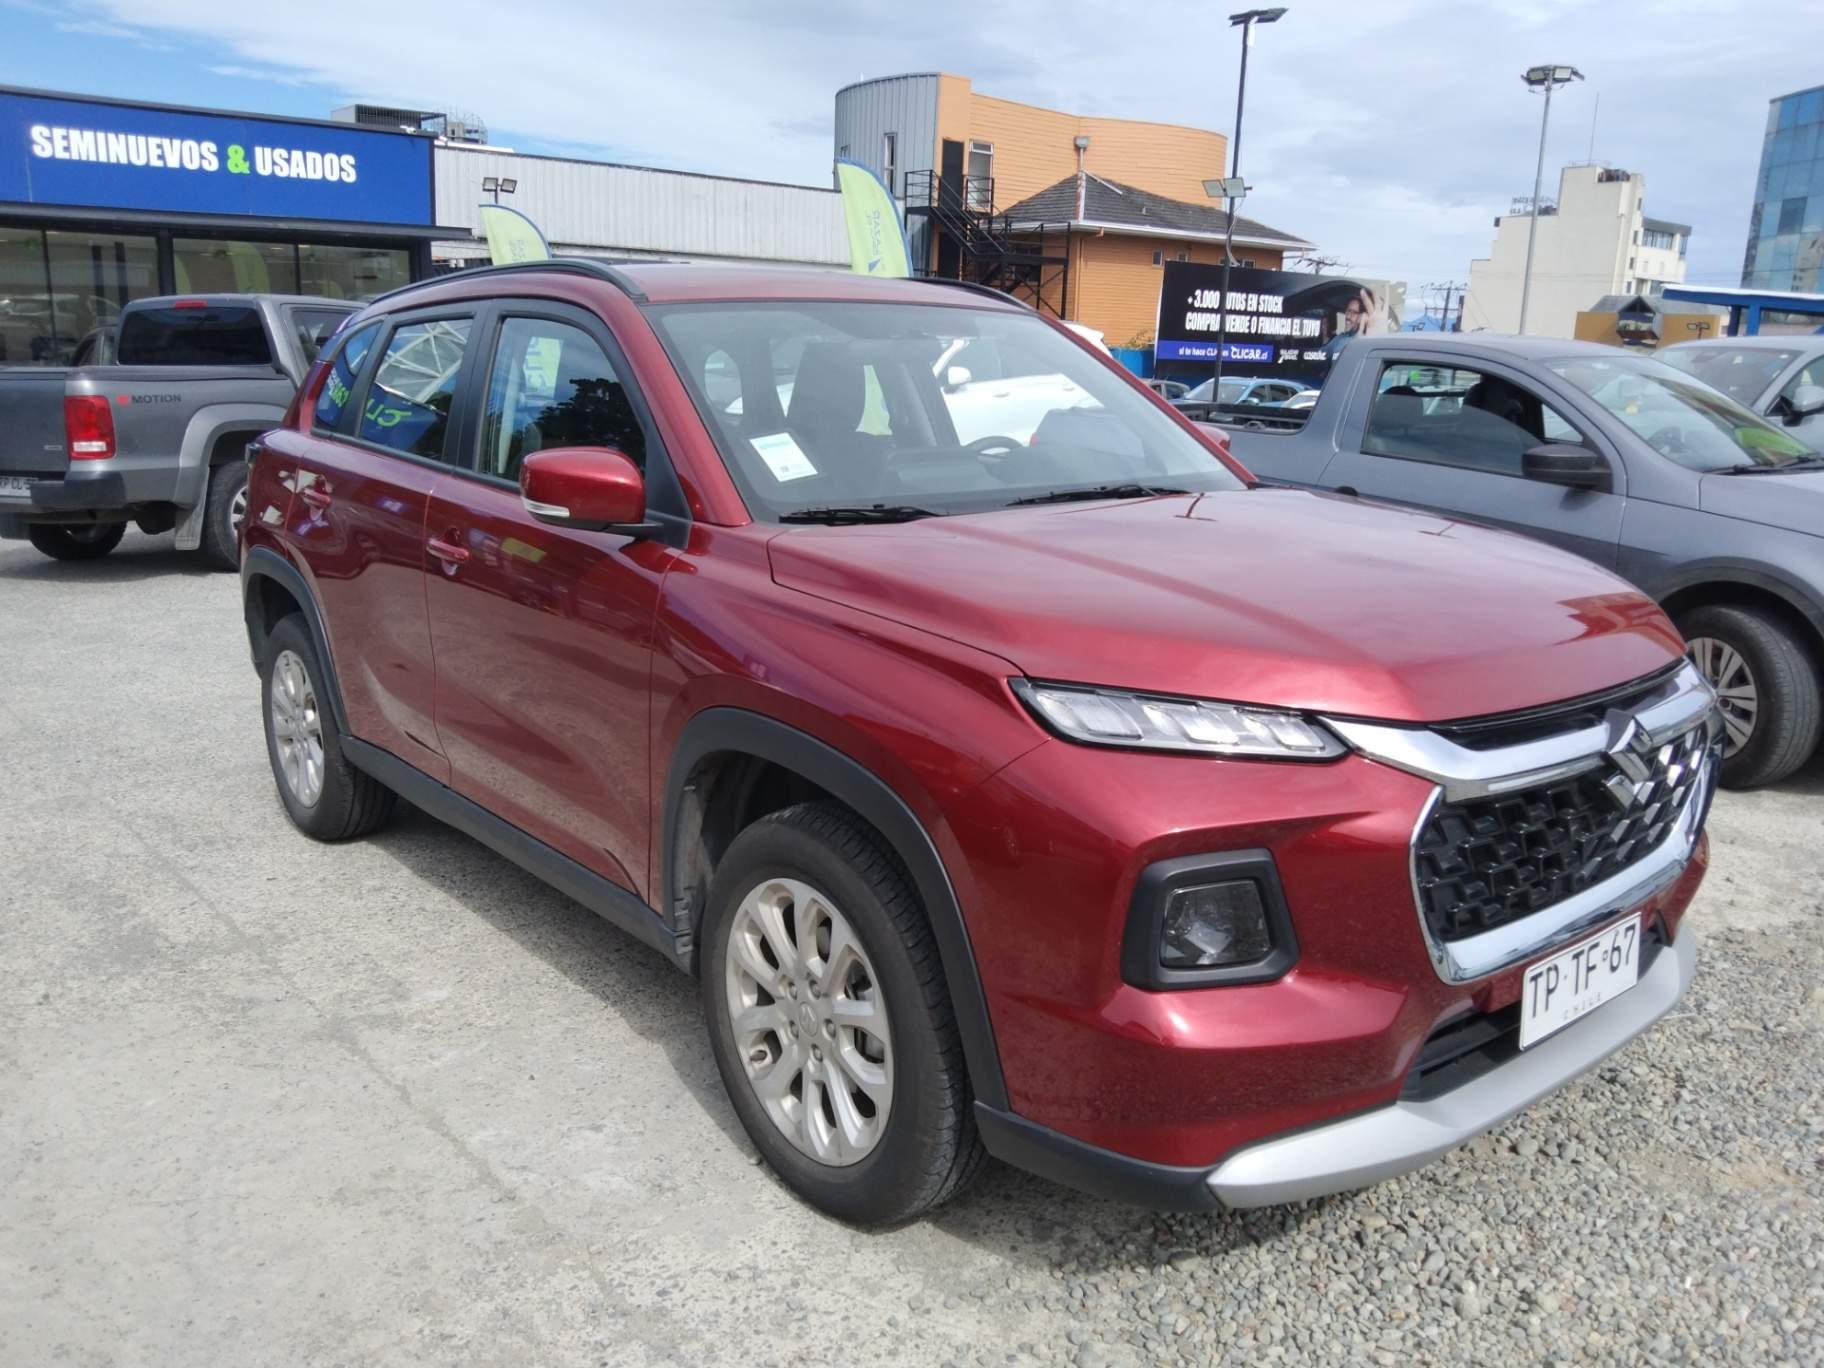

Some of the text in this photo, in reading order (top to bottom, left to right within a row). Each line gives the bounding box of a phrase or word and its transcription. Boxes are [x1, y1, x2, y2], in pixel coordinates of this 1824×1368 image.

[30, 124, 357, 184] SEMINUEVOS & USADOS
[1194, 289, 1220, 309] 3.000
[1225, 291, 1246, 311] UTOS
[1246, 293, 1258, 312] EN
[1258, 294, 1284, 313] STOCK
[1225, 314, 1250, 333] VENDE
[1250, 315, 1257, 334] O
[1257, 316, 1292, 336] FINANCIA
[1292, 318, 1301, 336] EL
[1302, 319, 1321, 337] TUYO
